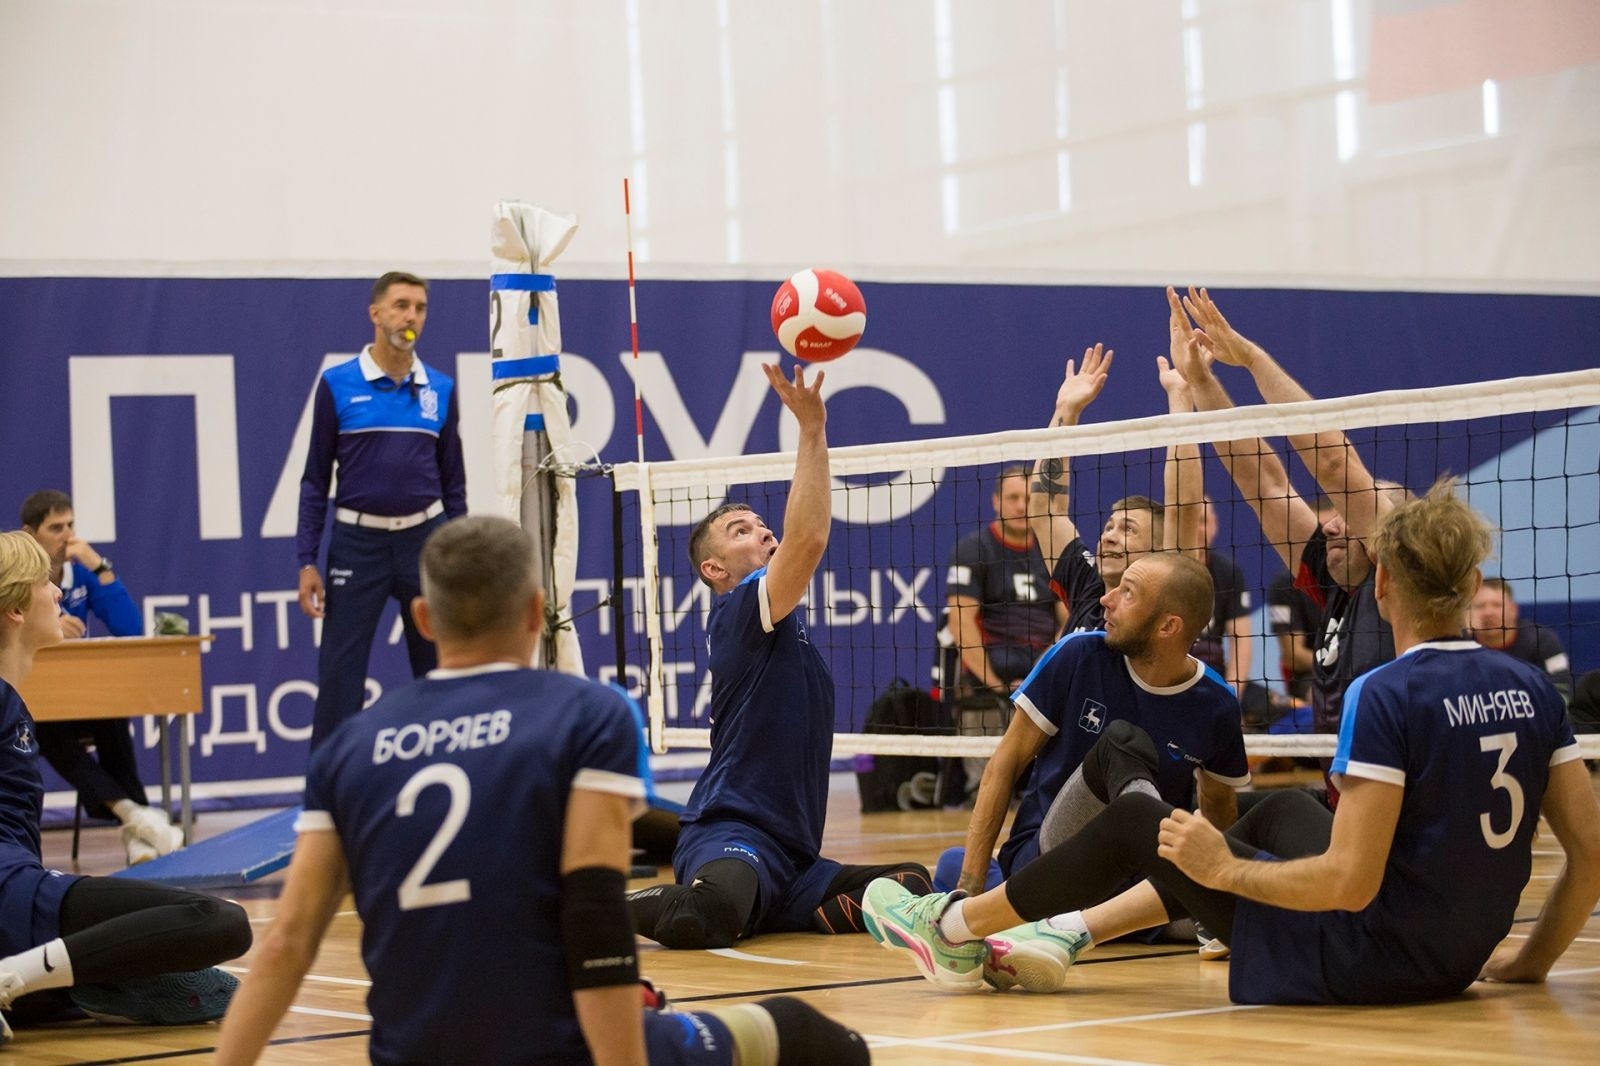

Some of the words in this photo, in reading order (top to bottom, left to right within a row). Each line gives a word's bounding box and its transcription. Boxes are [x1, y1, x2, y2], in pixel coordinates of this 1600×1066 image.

[371, 709, 513, 765] БОРЯЕВ
[1443, 689, 1536, 728] МИНЯЕВ
[1479, 731, 1526, 850] 3
[395, 762, 472, 912] 2
